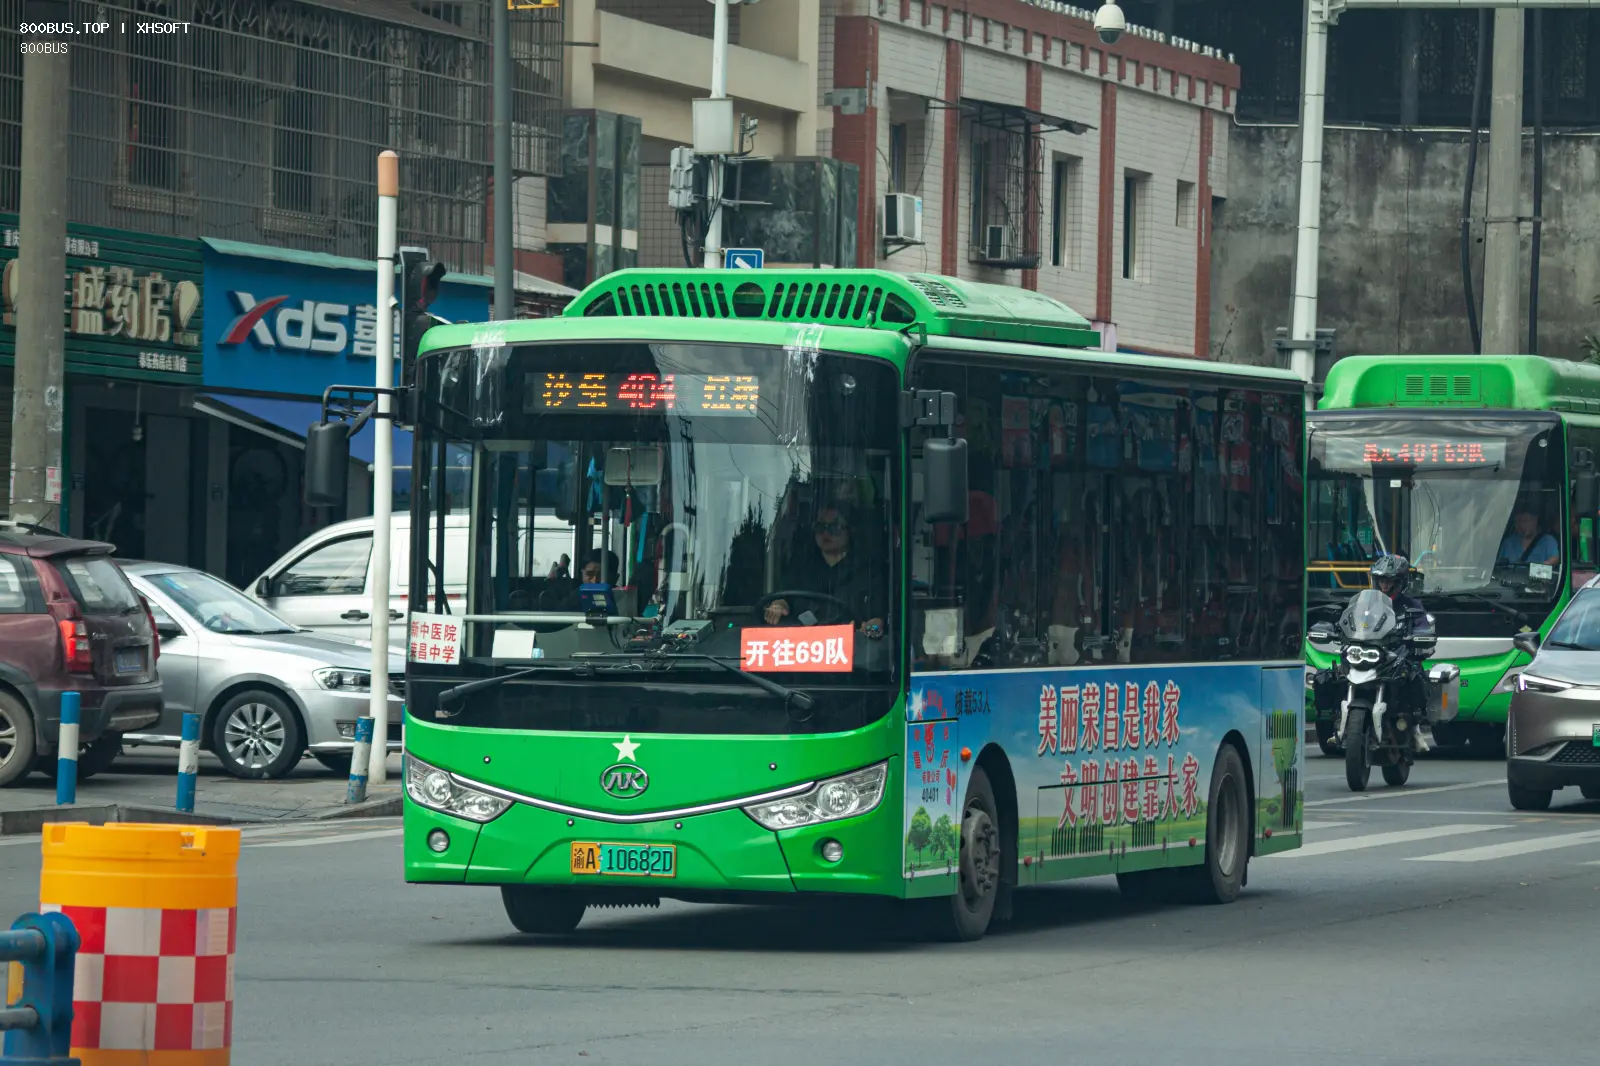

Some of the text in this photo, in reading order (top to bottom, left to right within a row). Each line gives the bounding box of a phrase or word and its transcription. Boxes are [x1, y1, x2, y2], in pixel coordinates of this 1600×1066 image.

[618, 374, 676, 409] 404
[745, 637, 849, 667] 开往69队
[1037, 679, 1182, 757] 美丽荣昌是我家
[921, 787, 940, 802] 40401
[1057, 751, 1200, 829] 文明创建靠大家
